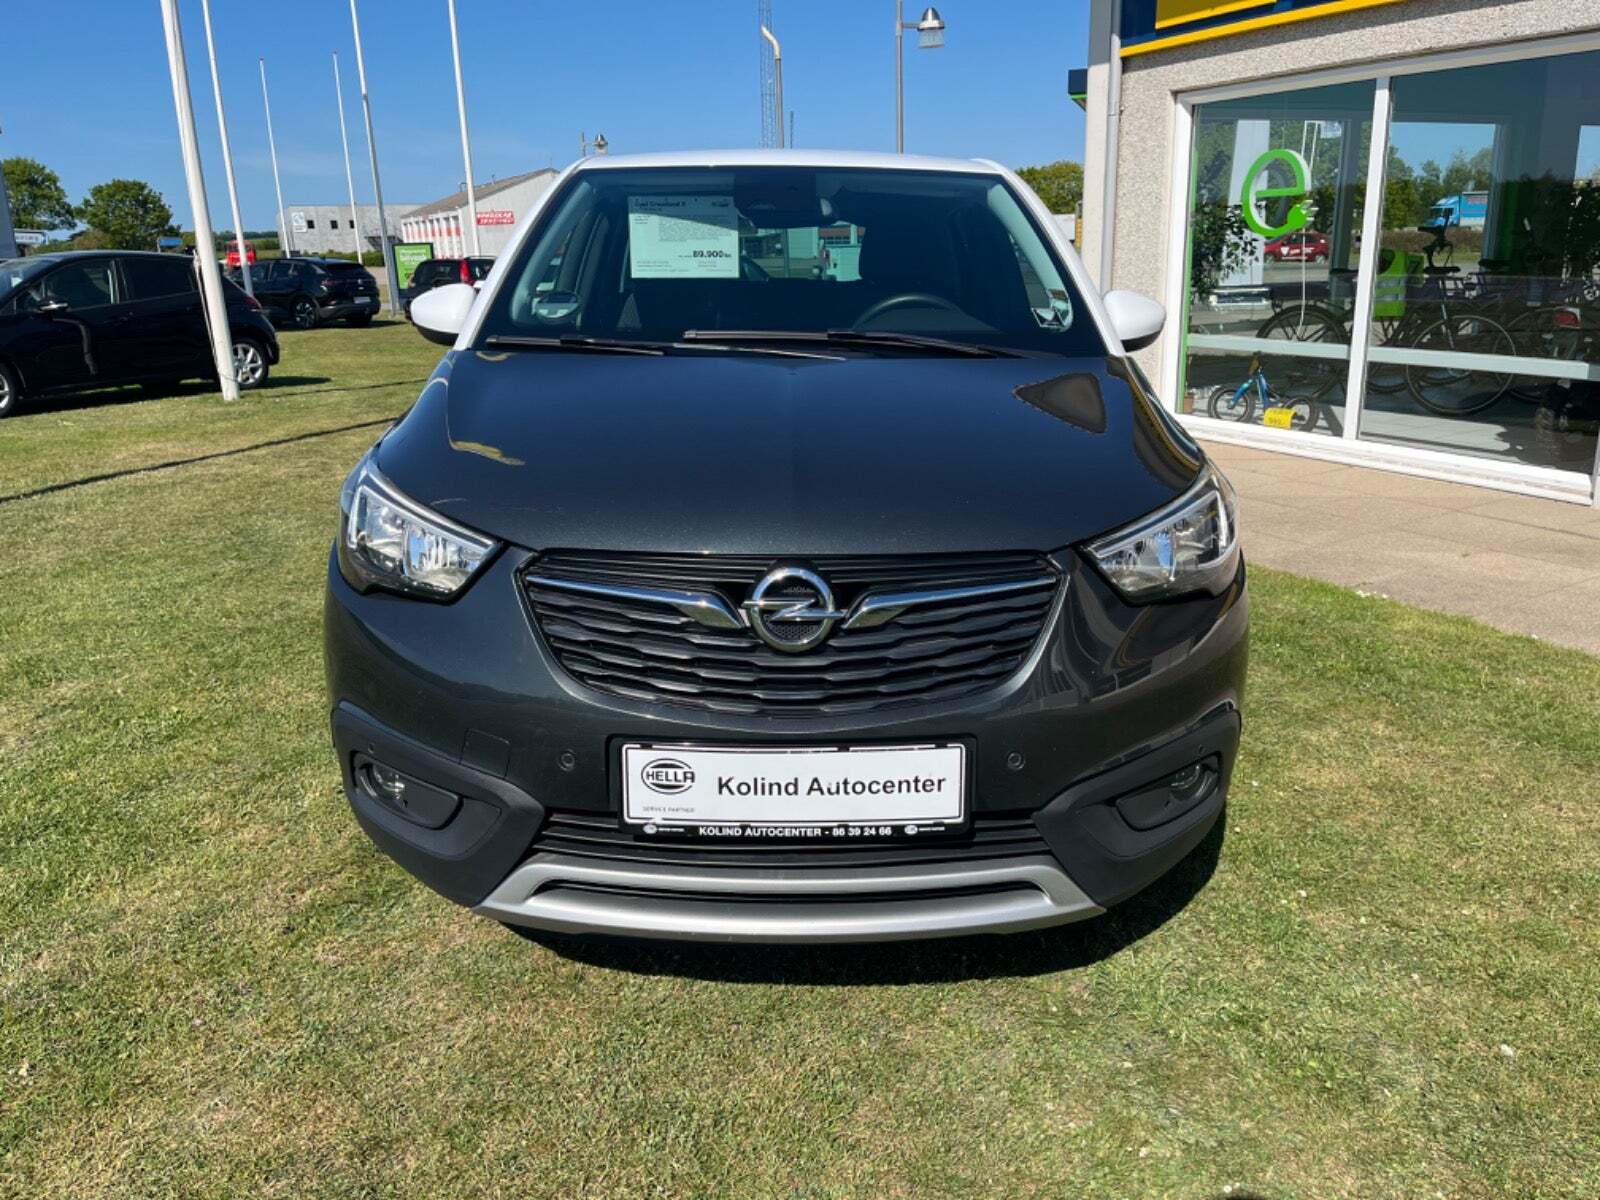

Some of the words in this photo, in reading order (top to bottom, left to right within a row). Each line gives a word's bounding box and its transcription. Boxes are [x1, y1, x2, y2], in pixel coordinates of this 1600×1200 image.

[645, 770, 696, 783] HELLA
[718, 776, 799, 796] Kolind
[806, 775, 947, 796] Autocenter
[699, 826, 742, 836] KOLIND
[744, 827, 822, 837] AUTOCENTER
[848, 826, 861, 836] 39
[863, 826, 877, 836] 24
